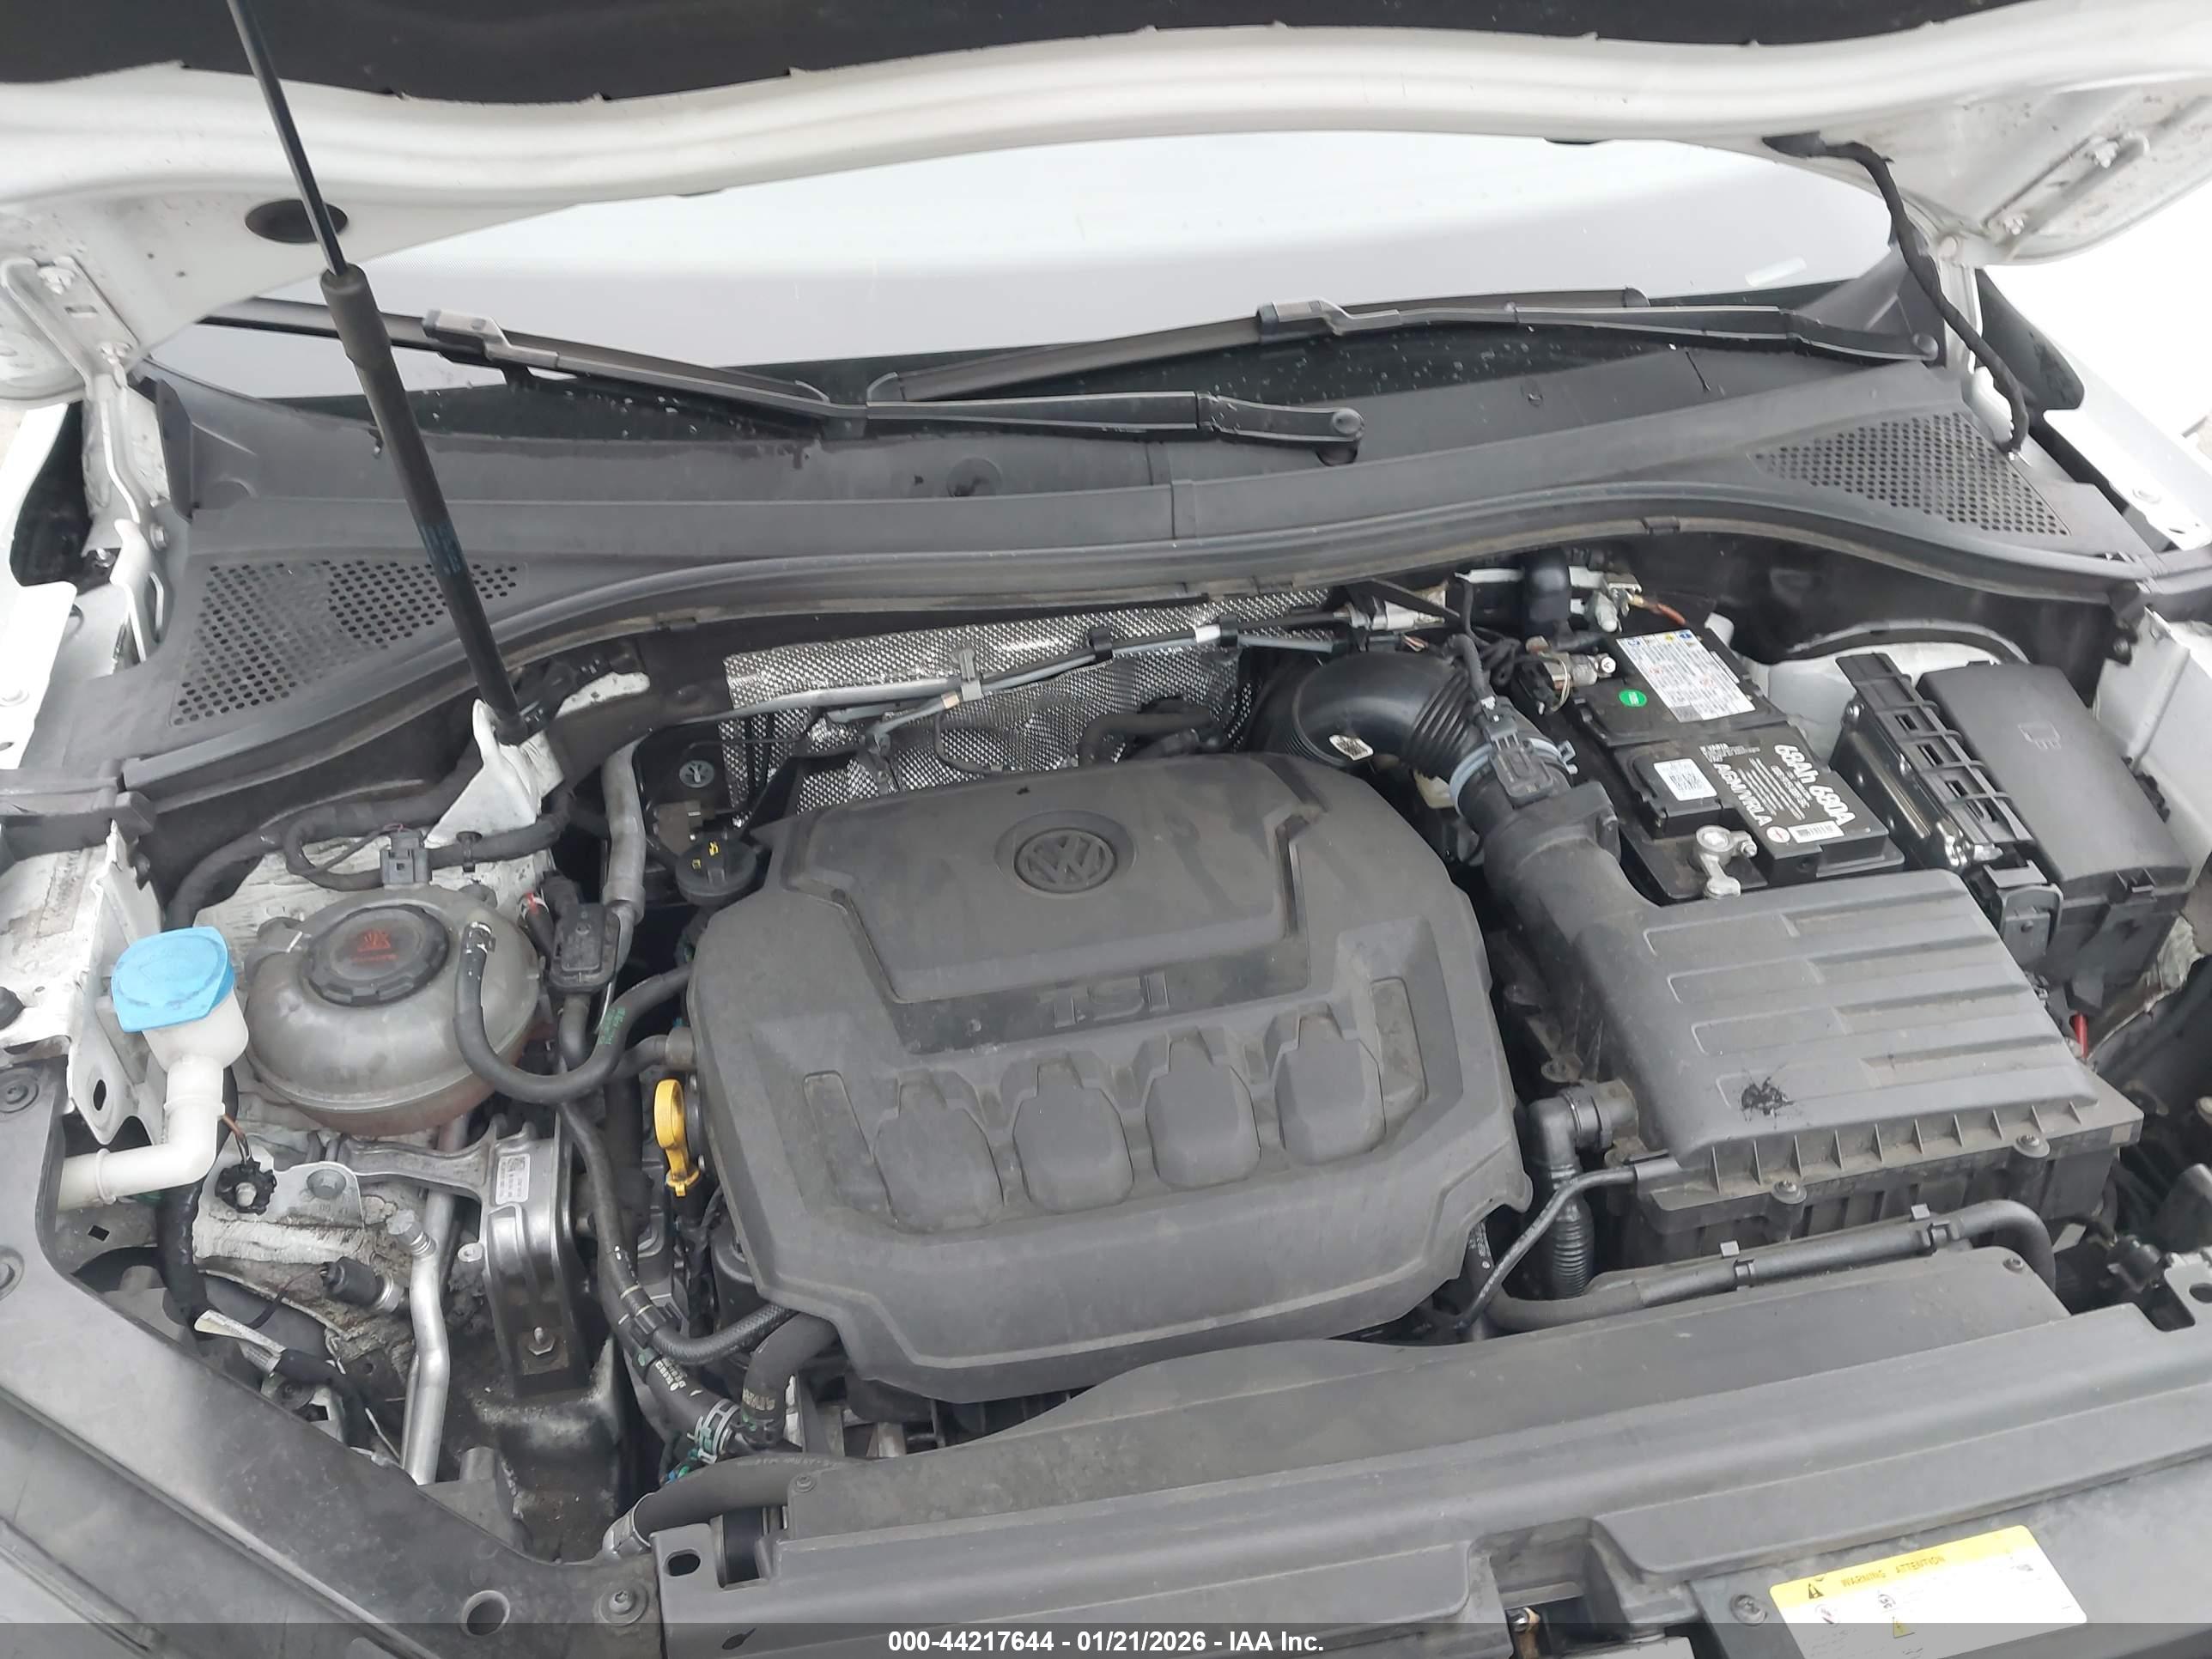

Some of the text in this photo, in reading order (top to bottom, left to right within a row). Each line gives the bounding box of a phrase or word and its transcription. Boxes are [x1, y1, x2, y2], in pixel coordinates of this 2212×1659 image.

[1774, 744, 1819, 783] 68Ah
[1808, 785, 1856, 826] 680A
[1036, 970, 1170, 1029] TSI
[1840, 1555, 1946, 1587] WARNING ATTENTION
